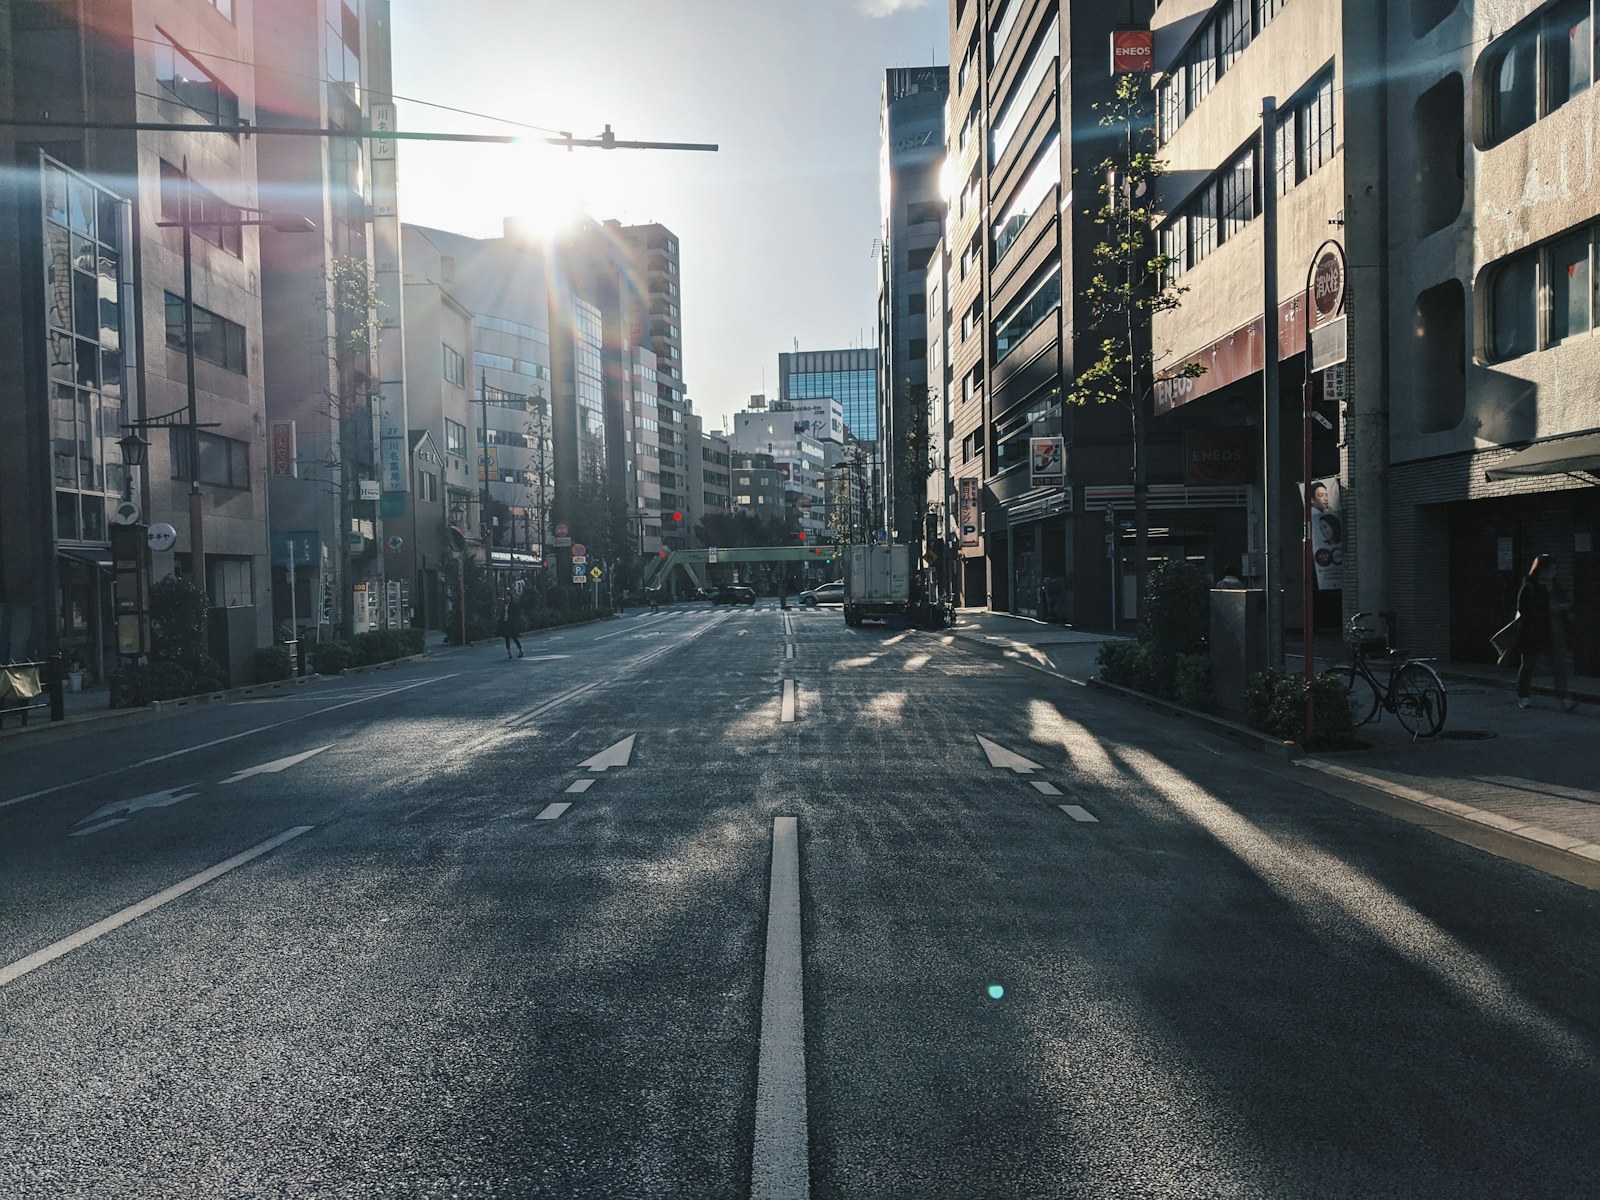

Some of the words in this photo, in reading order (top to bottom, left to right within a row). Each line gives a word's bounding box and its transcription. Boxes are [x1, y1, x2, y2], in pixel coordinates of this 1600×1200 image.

[1115, 47, 1151, 56] ENEOS
[1315, 267, 1339, 300] 消火栓
[1192, 449, 1241, 461] ENEOS
[963, 525, 976, 536] P
[575, 566, 582, 575] P
